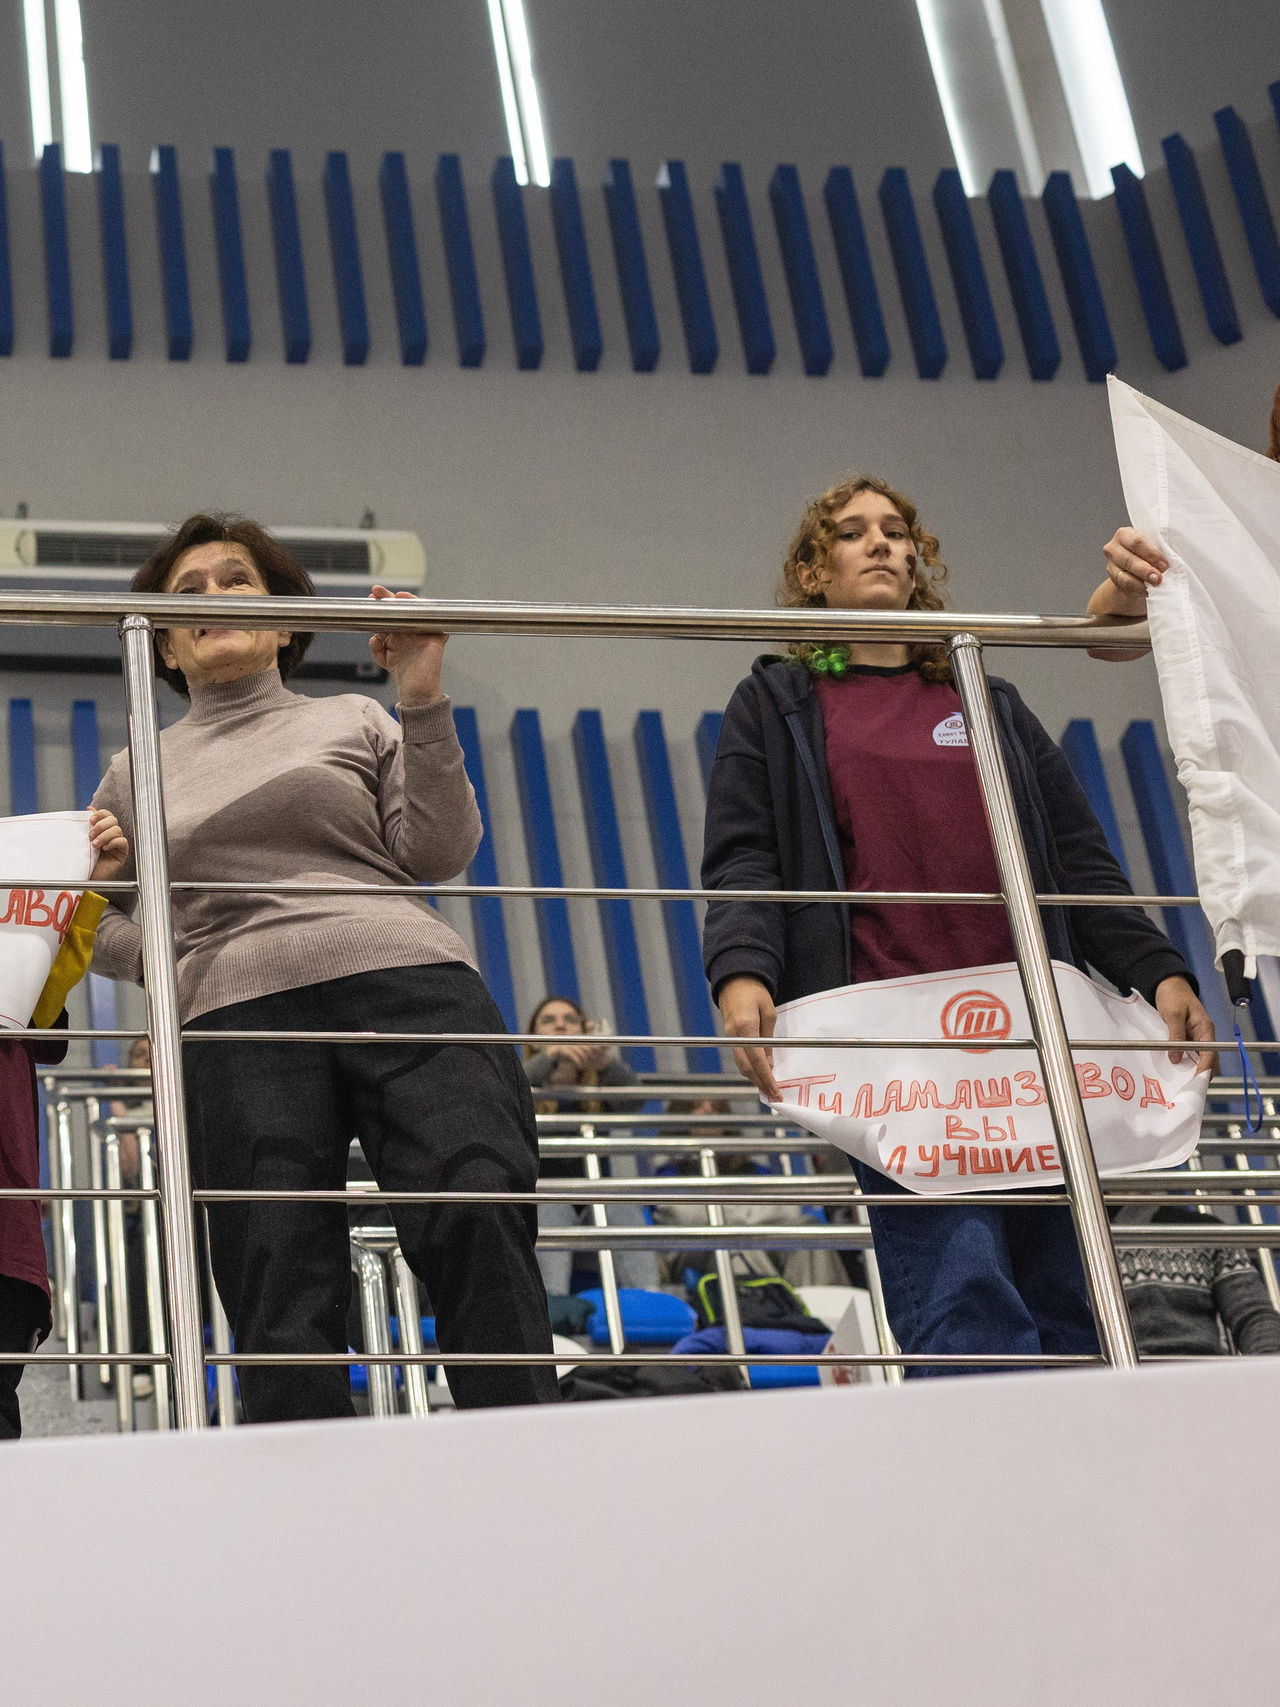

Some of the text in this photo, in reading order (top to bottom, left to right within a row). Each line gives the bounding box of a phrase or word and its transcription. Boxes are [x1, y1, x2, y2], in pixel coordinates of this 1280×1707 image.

[777, 1061, 1176, 1119] ТУЛАМАШЗВОД
[945, 1114, 1018, 1142] ВЫ
[885, 1143, 1061, 1178] ЛУЧШИЕ
